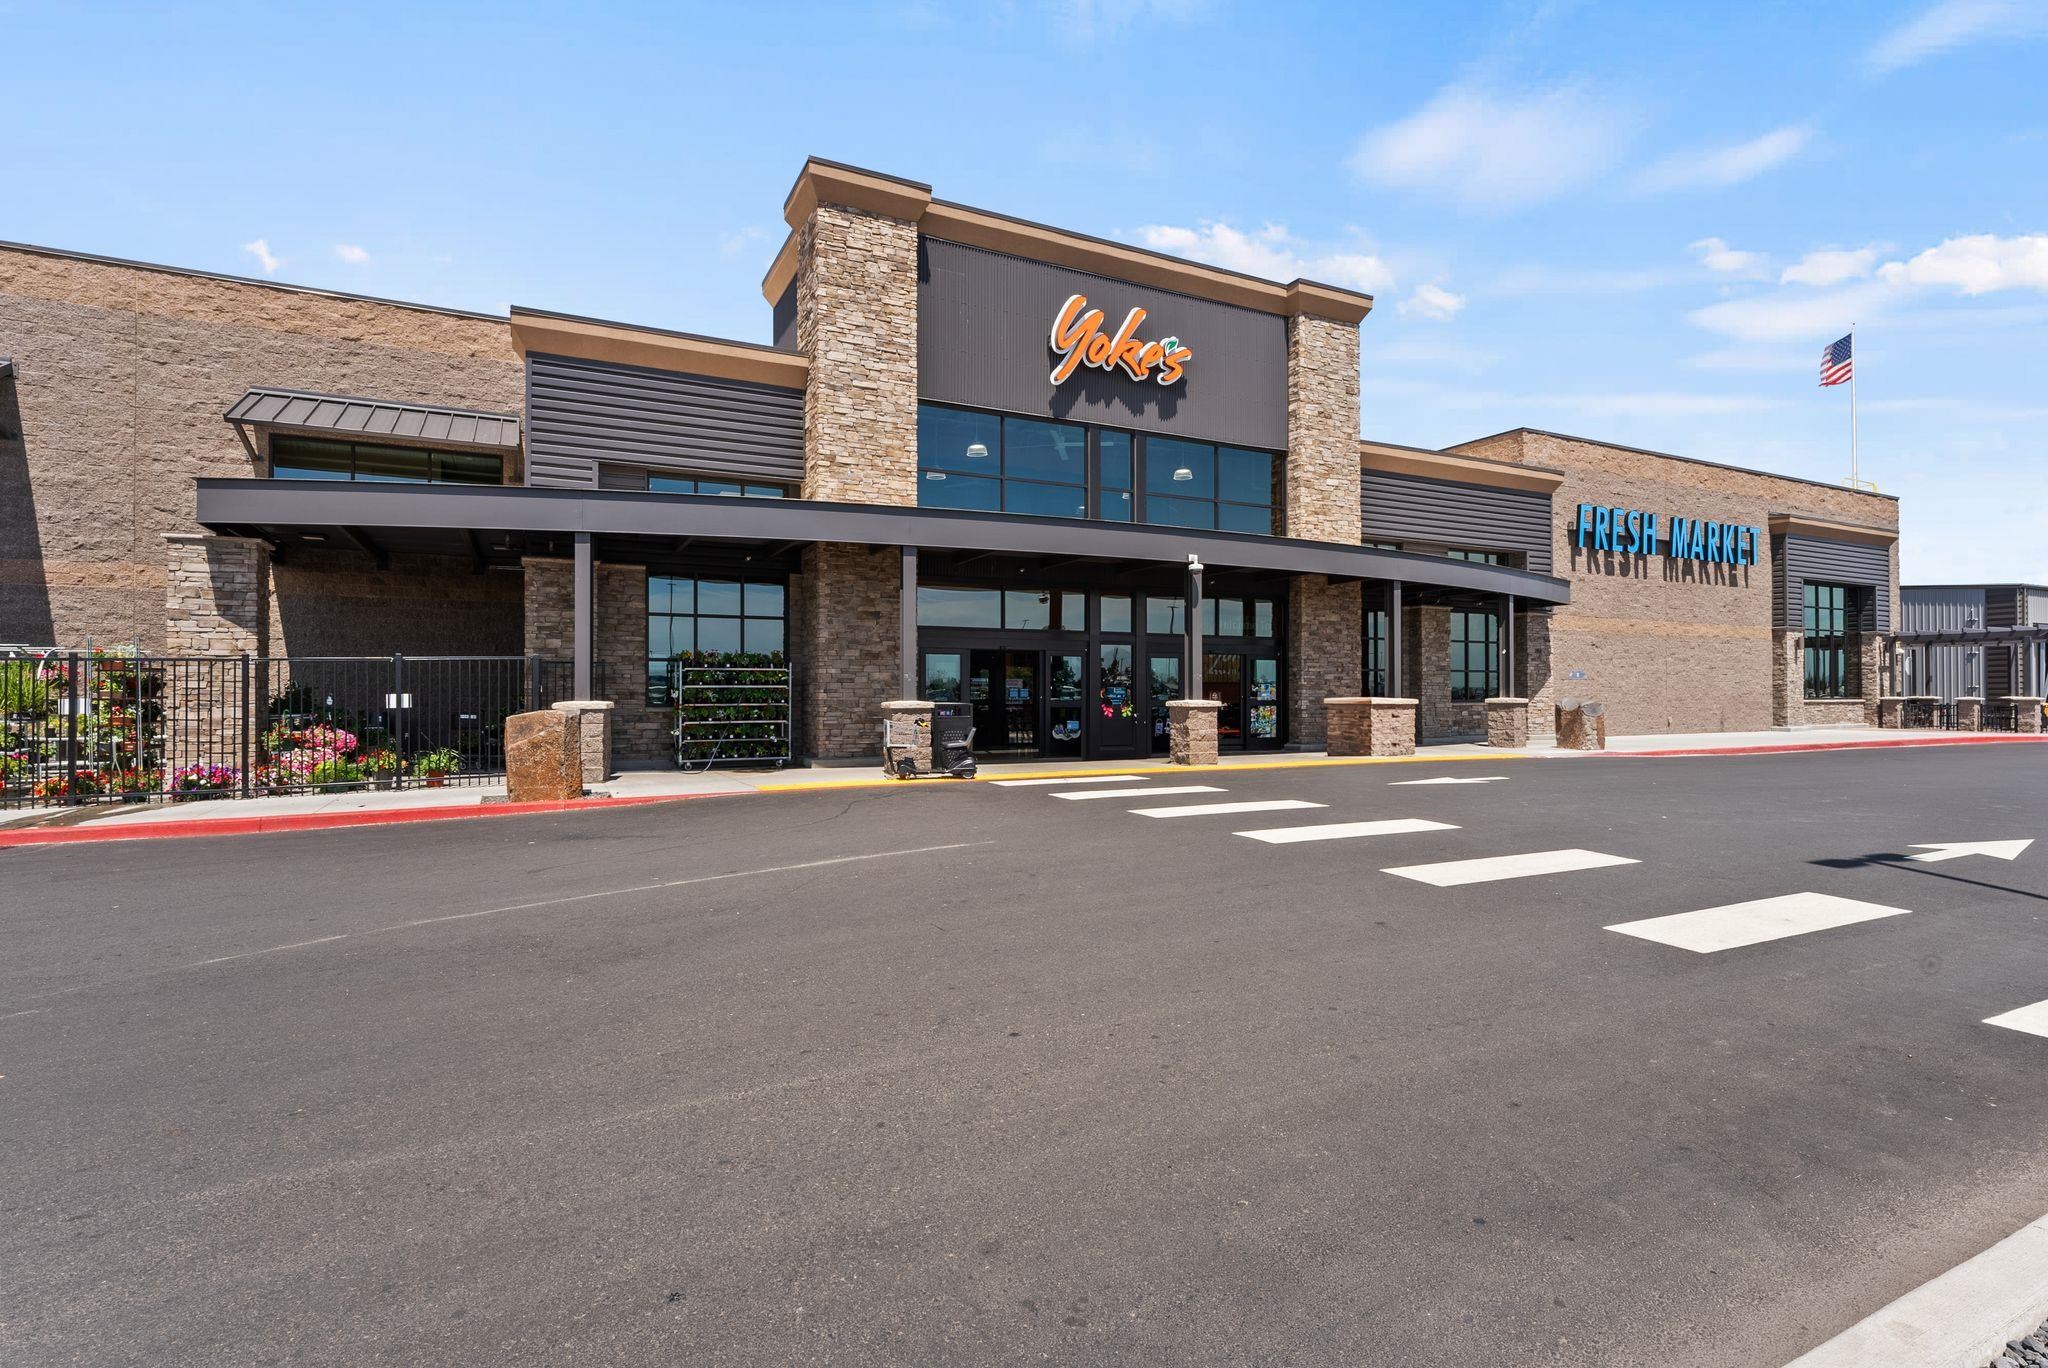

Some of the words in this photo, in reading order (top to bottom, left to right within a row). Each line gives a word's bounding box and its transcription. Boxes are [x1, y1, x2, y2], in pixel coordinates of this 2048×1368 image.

[1050, 294, 1192, 386] Yoke's
[1576, 503, 1657, 556] FRESH
[1670, 515, 1761, 566] MARKET
